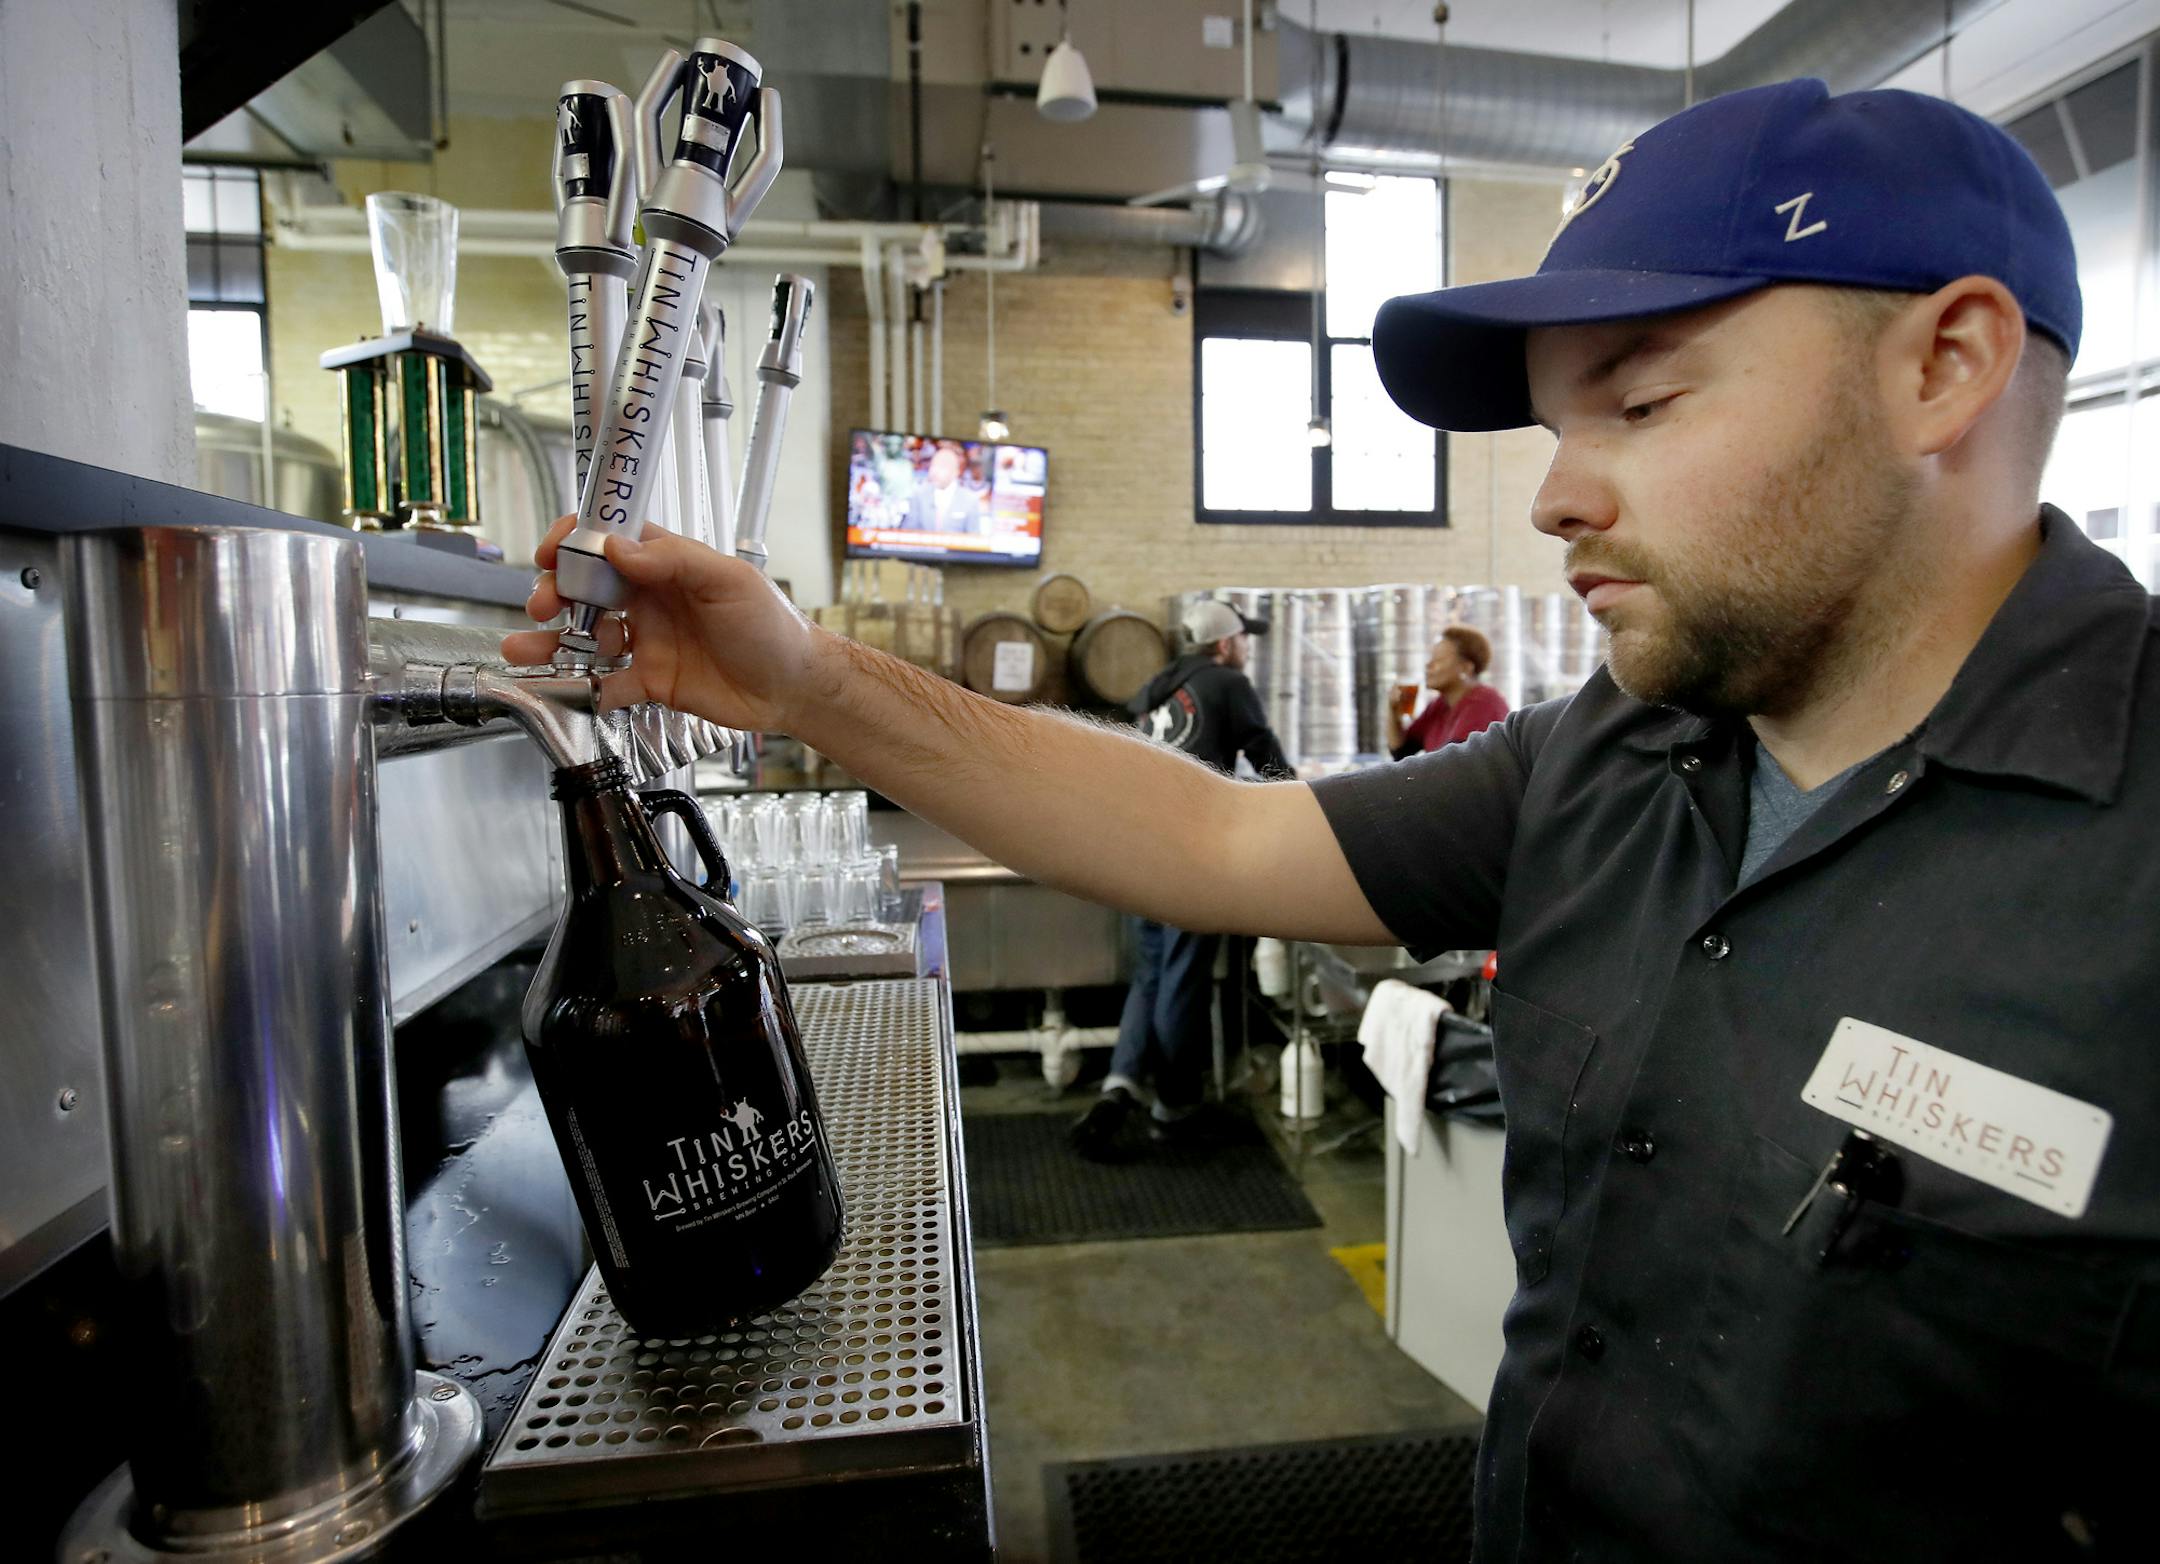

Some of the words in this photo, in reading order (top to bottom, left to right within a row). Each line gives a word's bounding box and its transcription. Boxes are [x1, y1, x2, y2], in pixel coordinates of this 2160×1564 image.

[1775, 191, 1827, 242] Z
[570, 275, 592, 331] TIN
[652, 250, 697, 310] TIN
[571, 344, 595, 501] WHISKE
[599, 316, 678, 525] WHISKERS
[1886, 1045, 1951, 1098] TIN
[667, 1126, 734, 1171] TIN
[1839, 1062, 2067, 1179] WHISKERS
[643, 1109, 814, 1210] WHISKERS
[693, 1169, 773, 1211] BREWING
